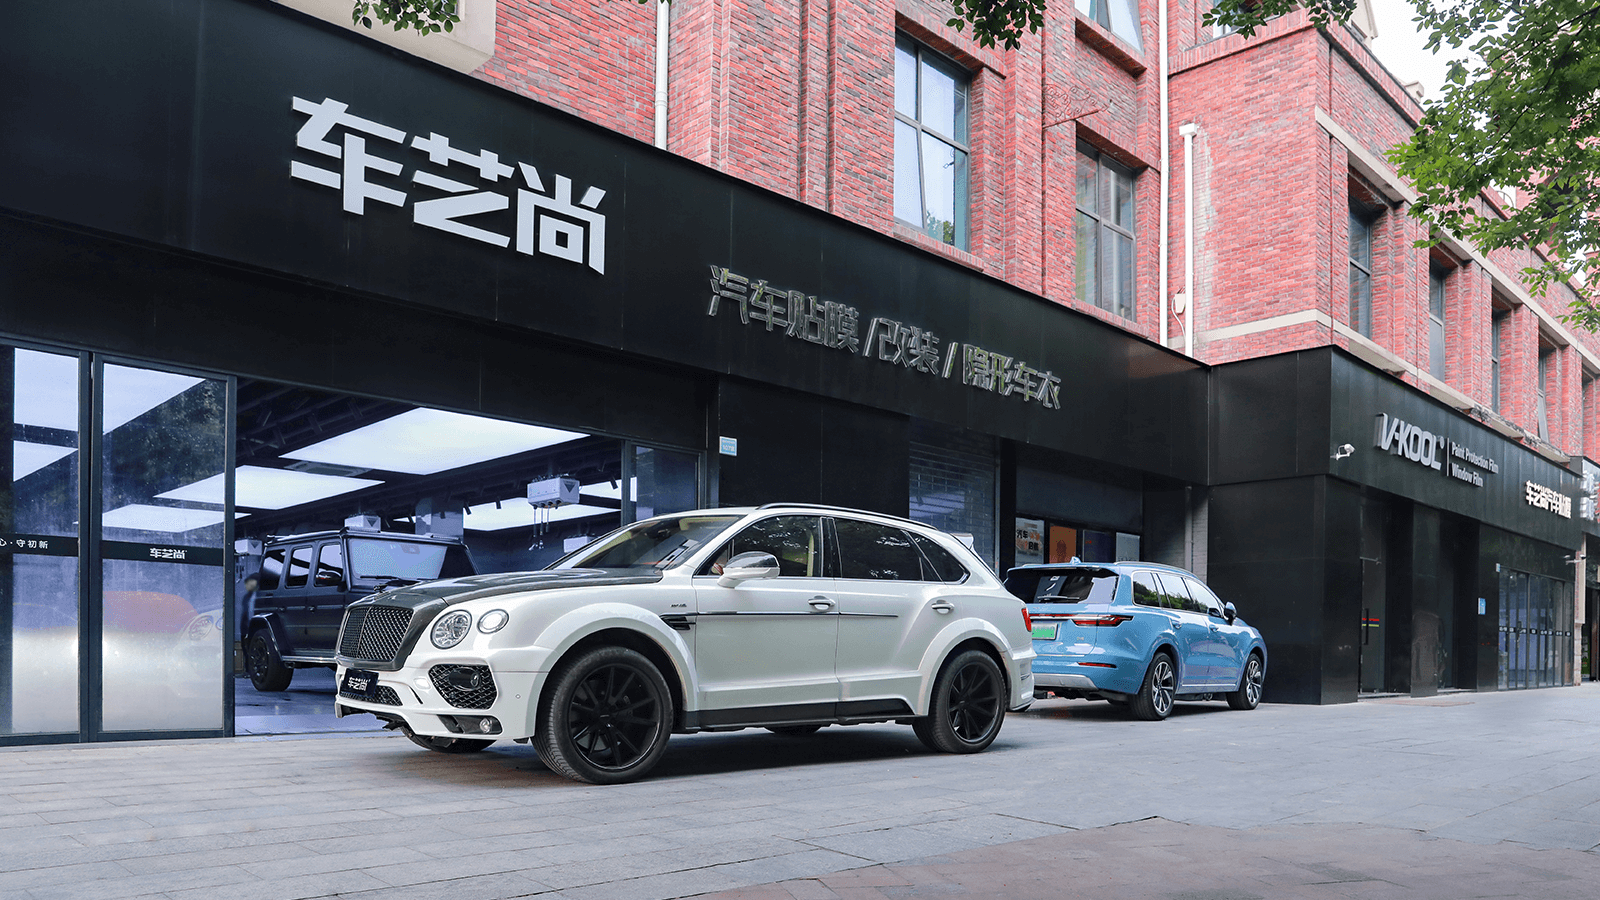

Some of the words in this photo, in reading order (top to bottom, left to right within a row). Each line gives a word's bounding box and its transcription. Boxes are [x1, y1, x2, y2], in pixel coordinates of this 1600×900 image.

[291, 96, 606, 275] 车艺尚
[708, 264, 859, 353] 汽车贴膜
[878, 317, 940, 375] 改装
[962, 343, 1062, 410] 隐形车衣
[1380, 412, 1442, 471] V-KOOL
[1451, 441, 1465, 460] Paint
[1465, 447, 1489, 470] Protection
[1488, 458, 1499, 474] Film
[1451, 462, 1473, 483] Window
[1472, 471, 1484, 487] Film
[149, 547, 186, 560] 车艺尚
